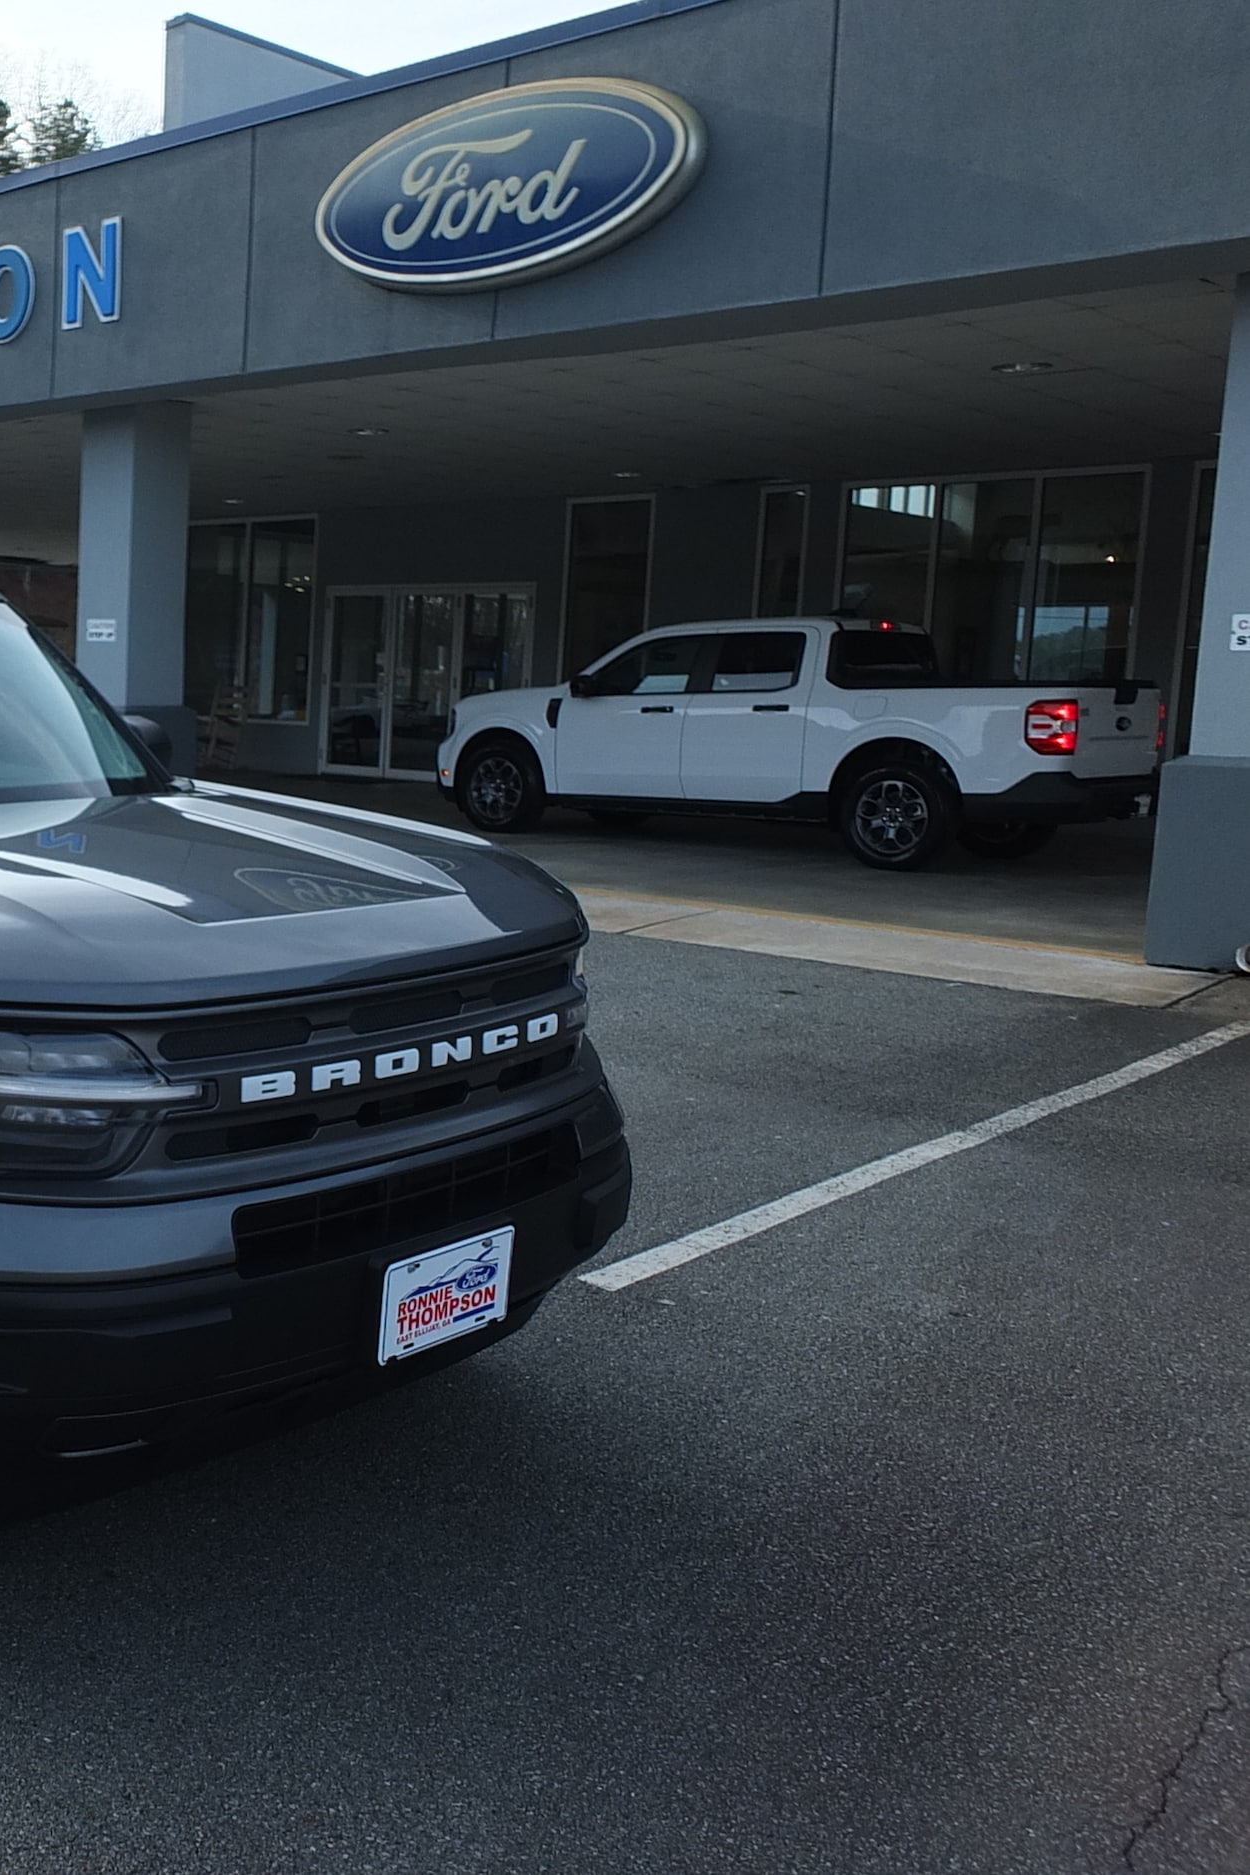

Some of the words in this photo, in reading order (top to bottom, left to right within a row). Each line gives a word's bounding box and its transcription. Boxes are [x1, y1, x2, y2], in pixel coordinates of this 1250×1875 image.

[382, 129, 588, 251] Ford
[240, 1012, 559, 1104] BRONCO
[461, 1267, 491, 1289] Ford
[397, 1284, 496, 1334] THOMPSON
[398, 1285, 453, 1317] RONNIE
[396, 1332, 412, 1344] EAST
